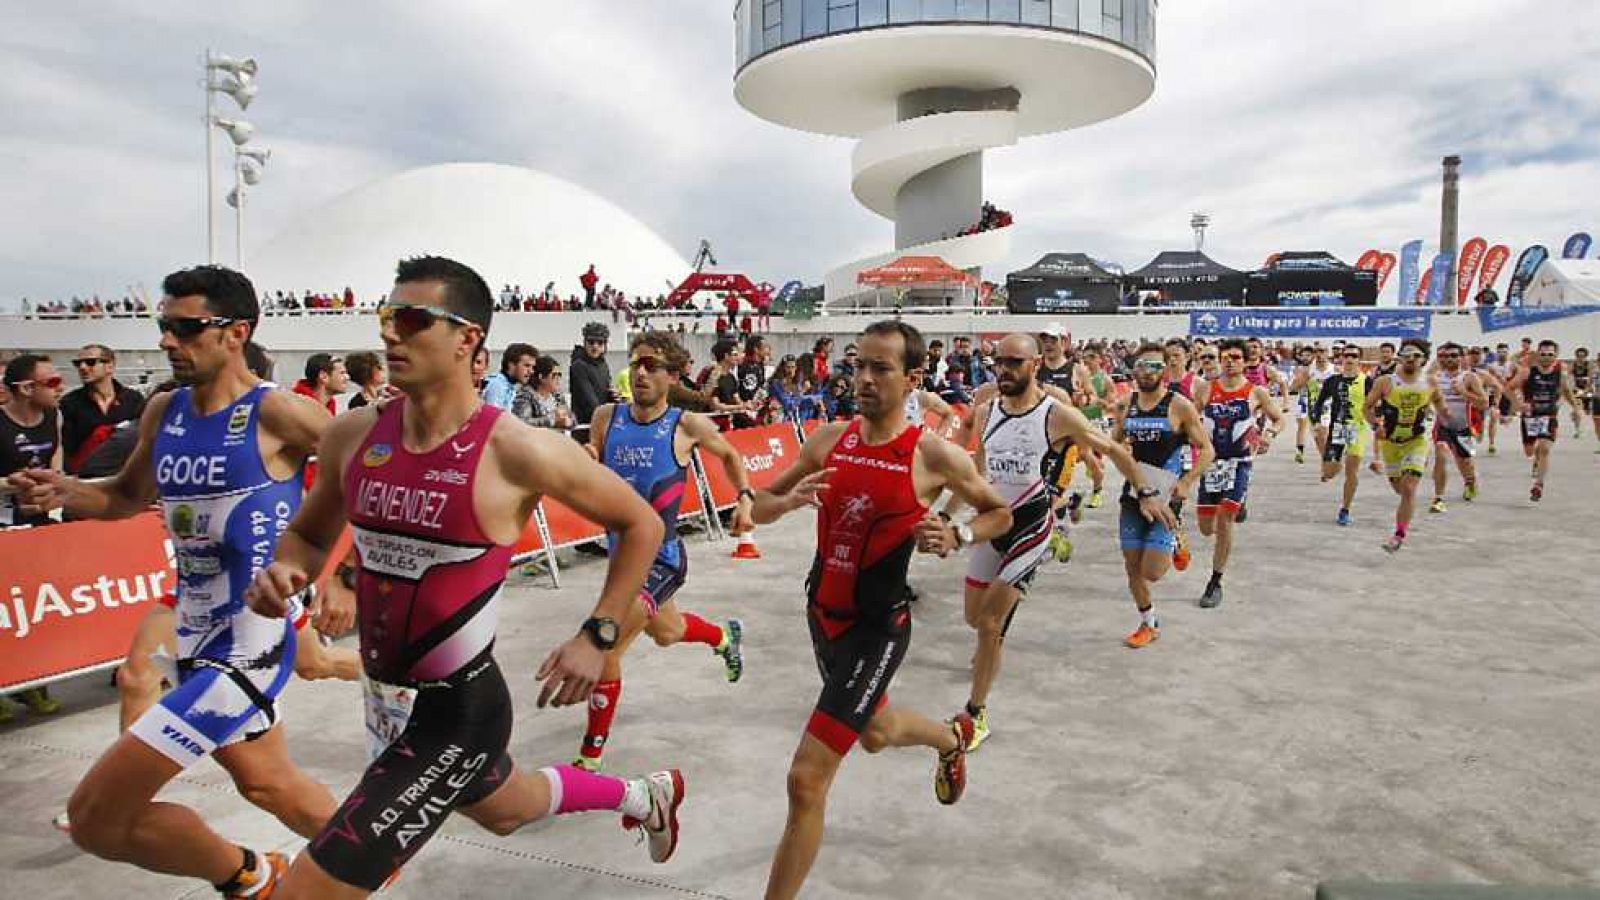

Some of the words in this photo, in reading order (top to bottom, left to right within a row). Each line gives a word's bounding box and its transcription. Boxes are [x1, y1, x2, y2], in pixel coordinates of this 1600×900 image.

[1273, 316, 1300, 330] para
[1305, 314, 1317, 329] la
[1319, 311, 1369, 329] acción?
[156, 453, 227, 486] GOCE
[357, 477, 449, 529] MENENDEZ
[367, 550, 417, 571] AVILES
[377, 539, 436, 559] TRIATLON
[370, 805, 400, 837] A.D.
[397, 743, 464, 806] TRIATLON
[396, 752, 489, 849] AVILES
